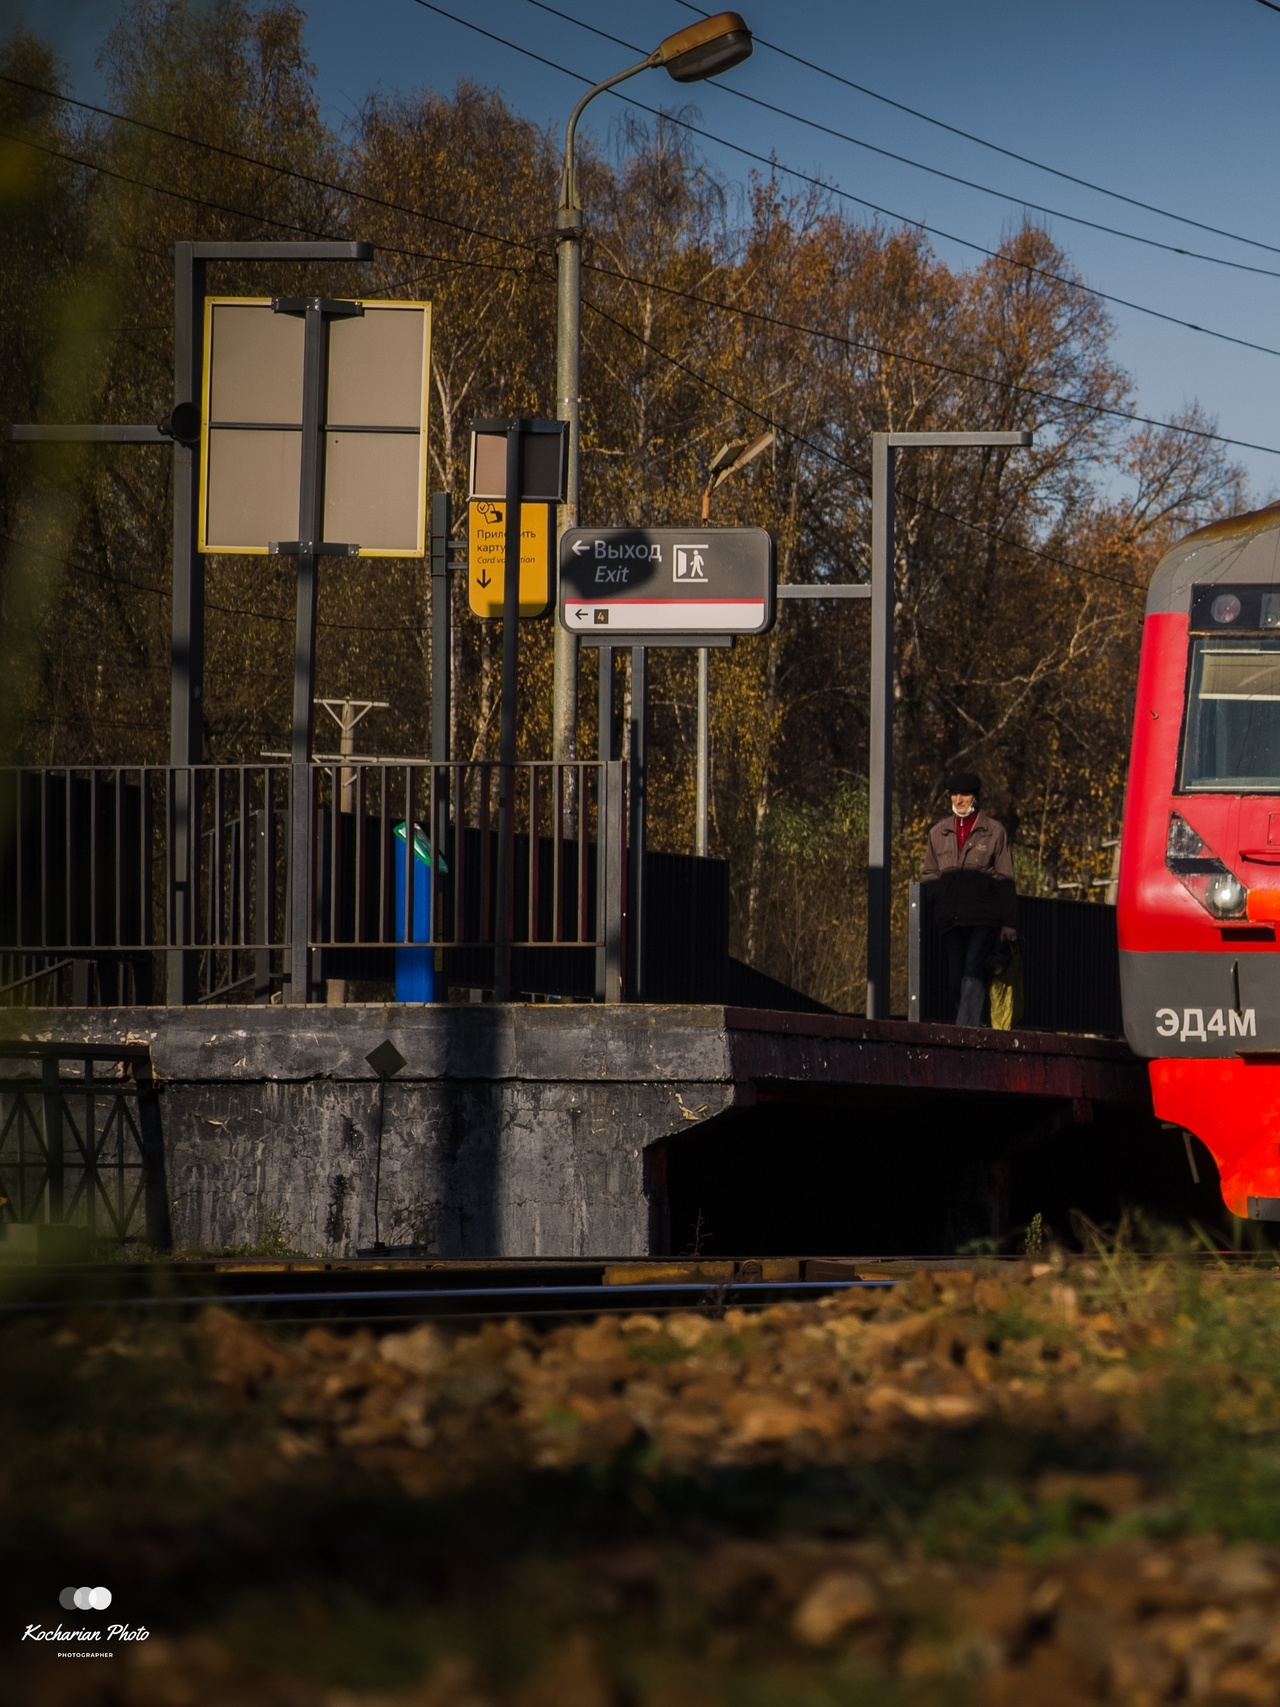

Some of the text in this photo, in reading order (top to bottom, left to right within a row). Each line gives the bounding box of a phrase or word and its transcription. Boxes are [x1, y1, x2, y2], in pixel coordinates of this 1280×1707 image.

[477, 529, 537, 541] Прилить
[477, 545, 506, 554] карту
[594, 540, 662, 562] Выход
[477, 556, 496, 564] Card
[594, 565, 629, 582] Exit
[597, 611, 605, 622] 4
[1155, 1008, 1257, 1042] ЭД4М
